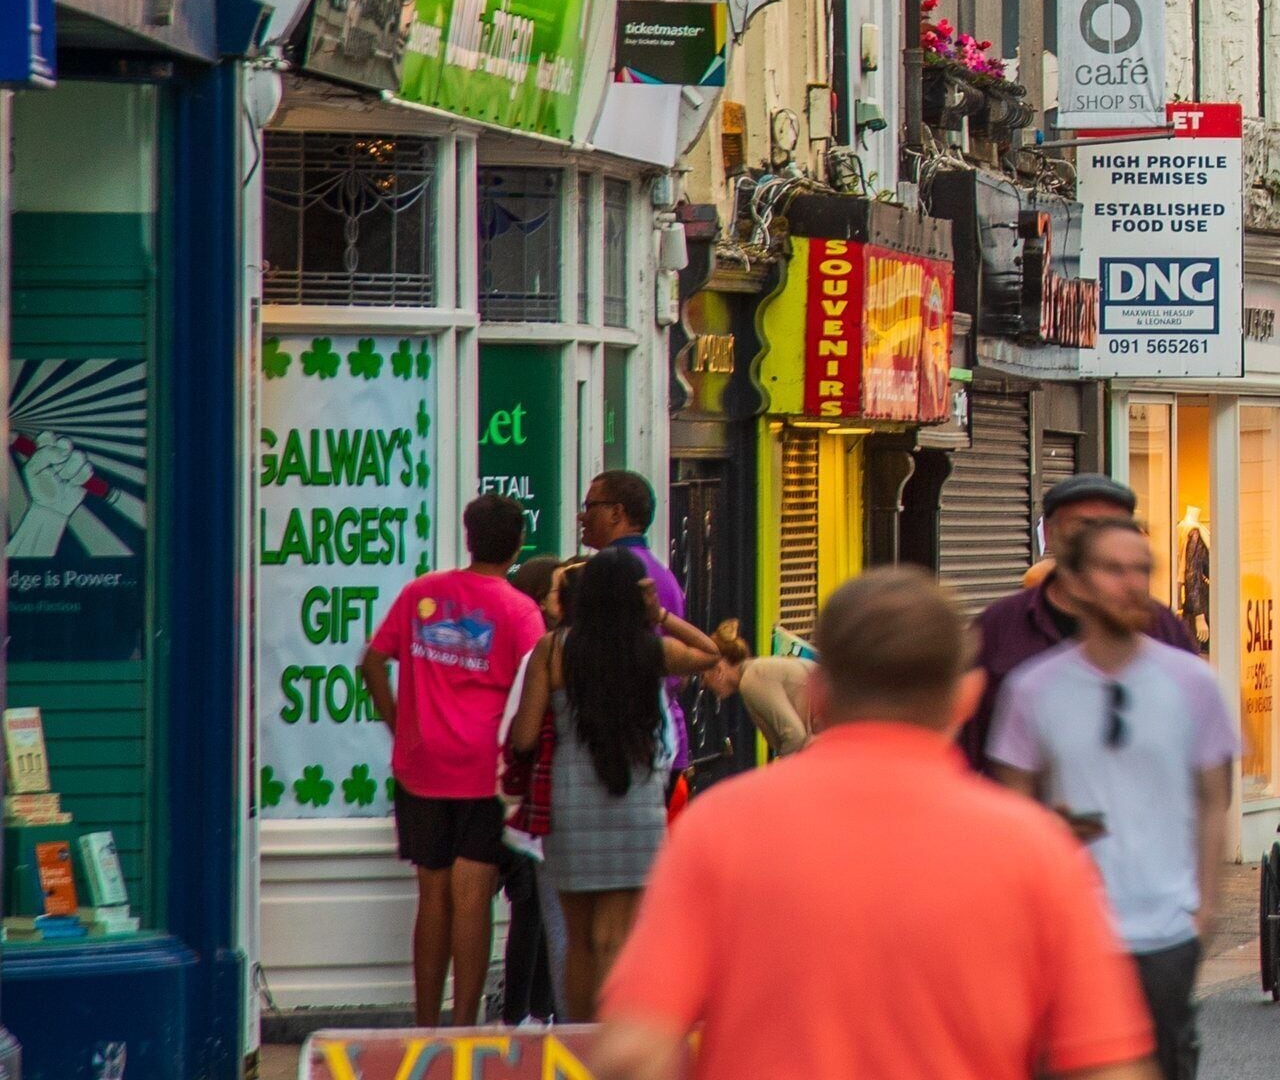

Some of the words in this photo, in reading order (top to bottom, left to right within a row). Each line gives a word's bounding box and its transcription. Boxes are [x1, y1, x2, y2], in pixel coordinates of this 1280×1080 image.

[625, 22, 701, 36] ticketmaster
[1075, 58, 1149, 87] café
[1076, 95, 1125, 110] SHOP
[1172, 111, 1204, 130] ET
[1092, 156, 1140, 169] HIGH
[1147, 156, 1227, 169] PROFILE
[1111, 172, 1208, 185] PREMISES
[1094, 204, 1225, 216] ESTABLISHED
[1112, 220, 1164, 233] FOOD
[1171, 220, 1208, 232] USE
[1109, 262, 1215, 302] DNG
[818, 238, 853, 417] SOUVENIRS
[1145, 318, 1183, 326] LEONARD
[1109, 339, 1138, 354] 091
[1147, 339, 1208, 354] 565261
[260, 427, 414, 487] GALWAY'S
[260, 507, 408, 565] LARGEST
[44, 570, 61, 587] is
[301, 586, 380, 644] GIFT
[1246, 599, 1273, 653] SALE
[280, 664, 392, 724] STOR
